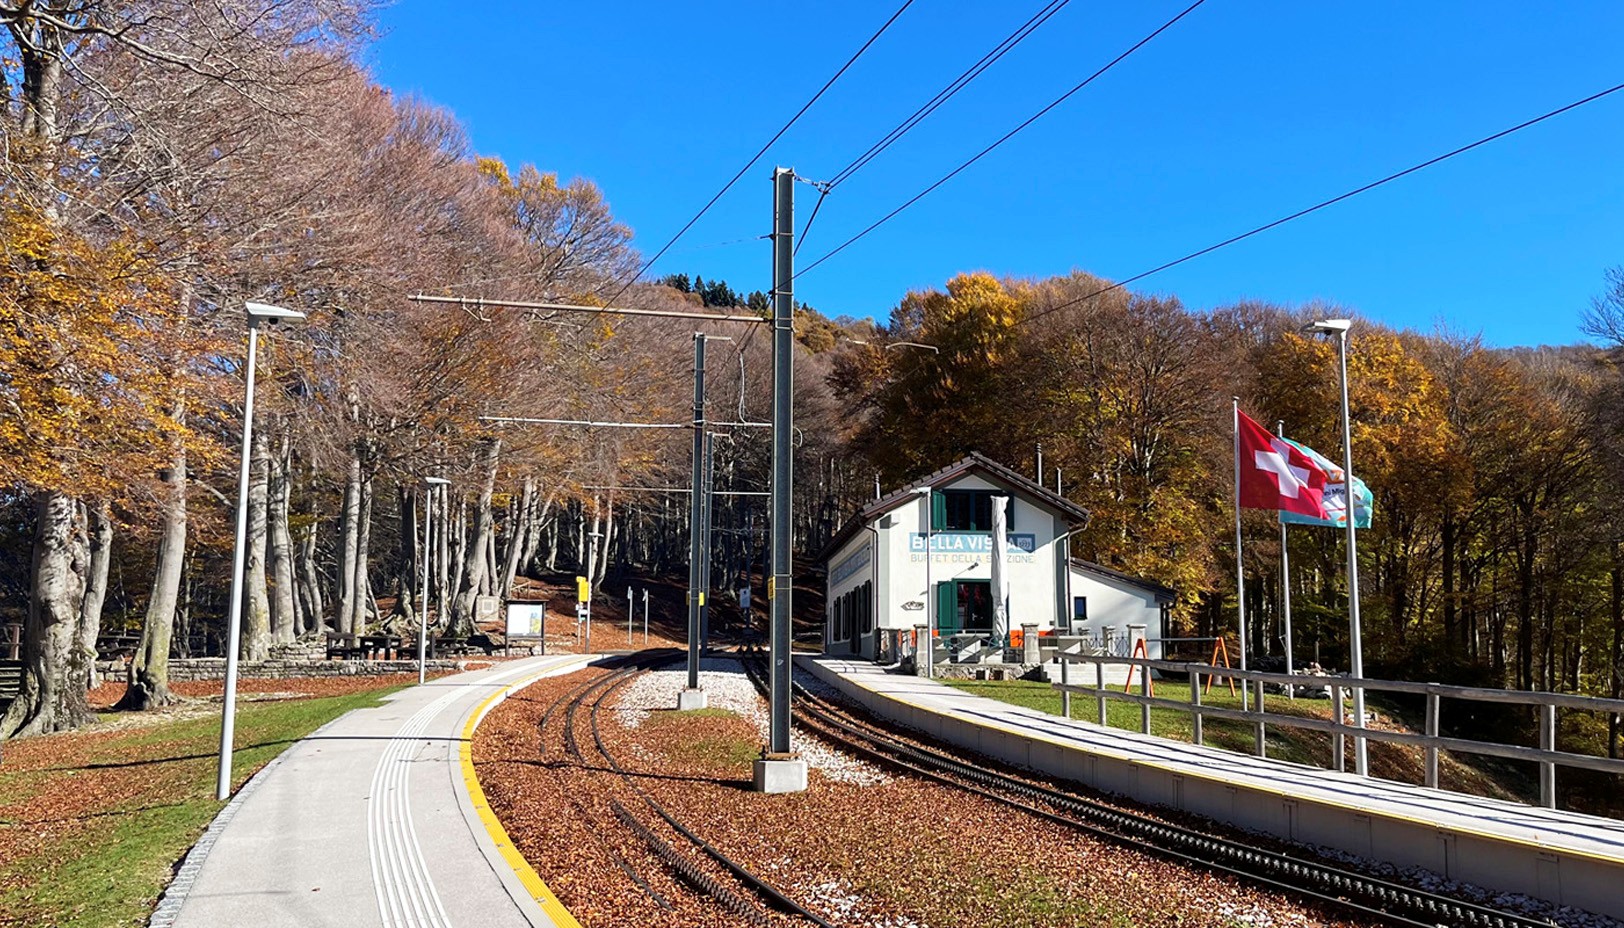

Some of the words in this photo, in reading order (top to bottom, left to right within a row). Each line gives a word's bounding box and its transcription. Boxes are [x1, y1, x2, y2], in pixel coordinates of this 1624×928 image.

[912, 536, 963, 550] BELLA
[967, 537, 1017, 550] VISA
[985, 555, 1034, 564] SZIONE
